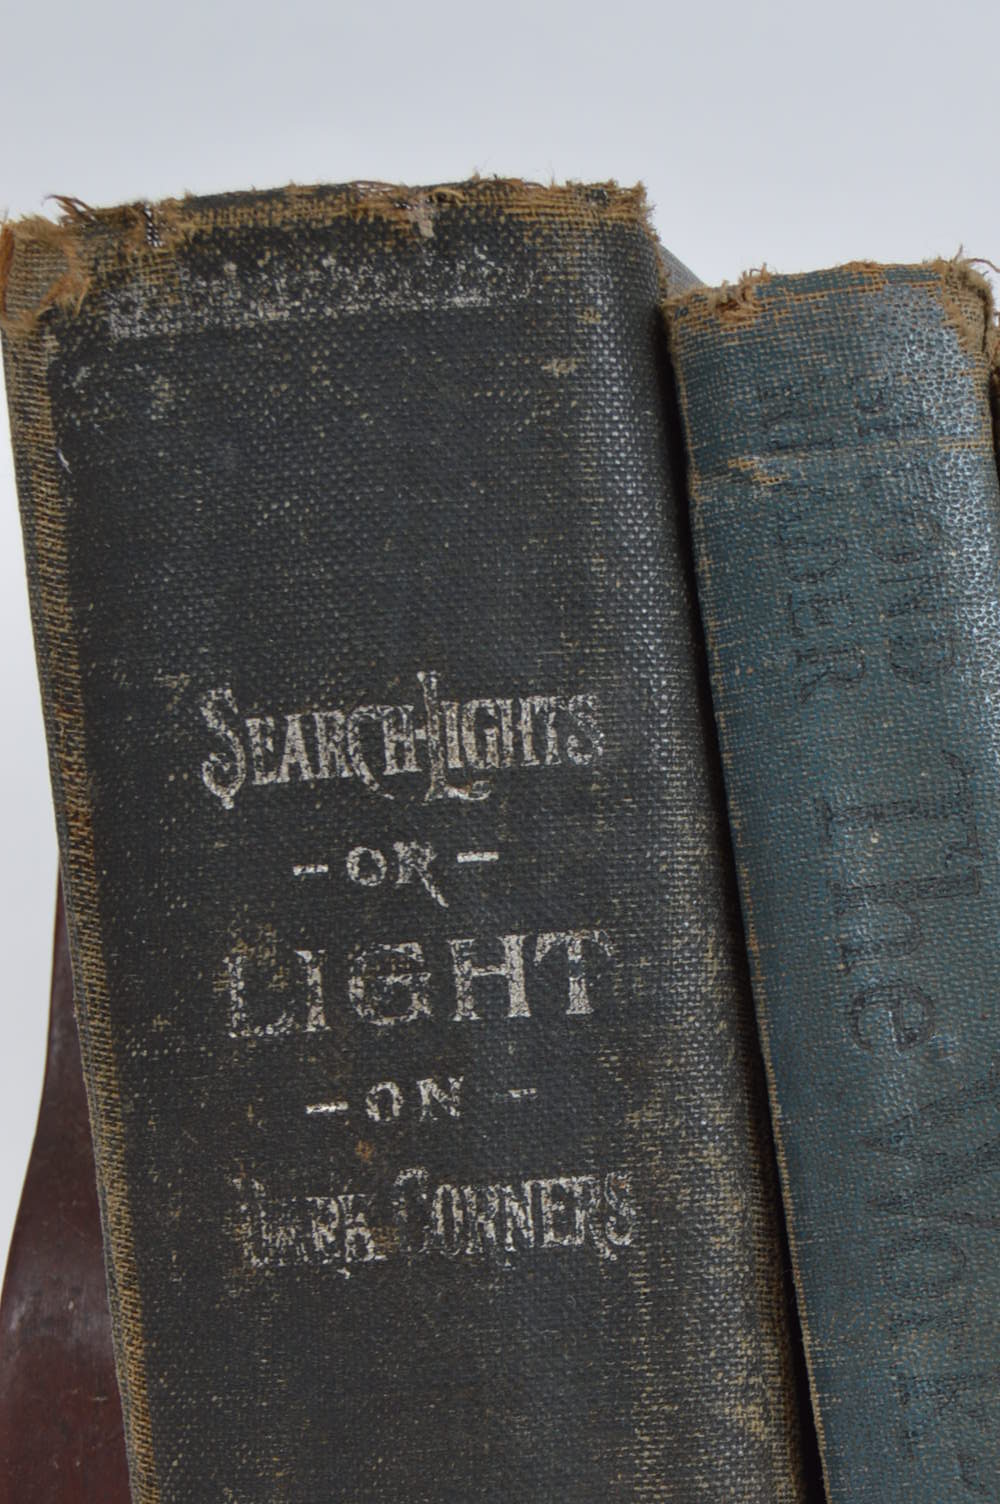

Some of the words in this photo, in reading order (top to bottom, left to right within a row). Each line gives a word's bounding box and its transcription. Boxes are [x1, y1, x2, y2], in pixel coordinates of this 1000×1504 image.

[345, 841, 449, 907] OR
[820, 749, 985, 1055] The
[226, 930, 615, 1039] LIGHT
[364, 1077, 464, 1122] ON
